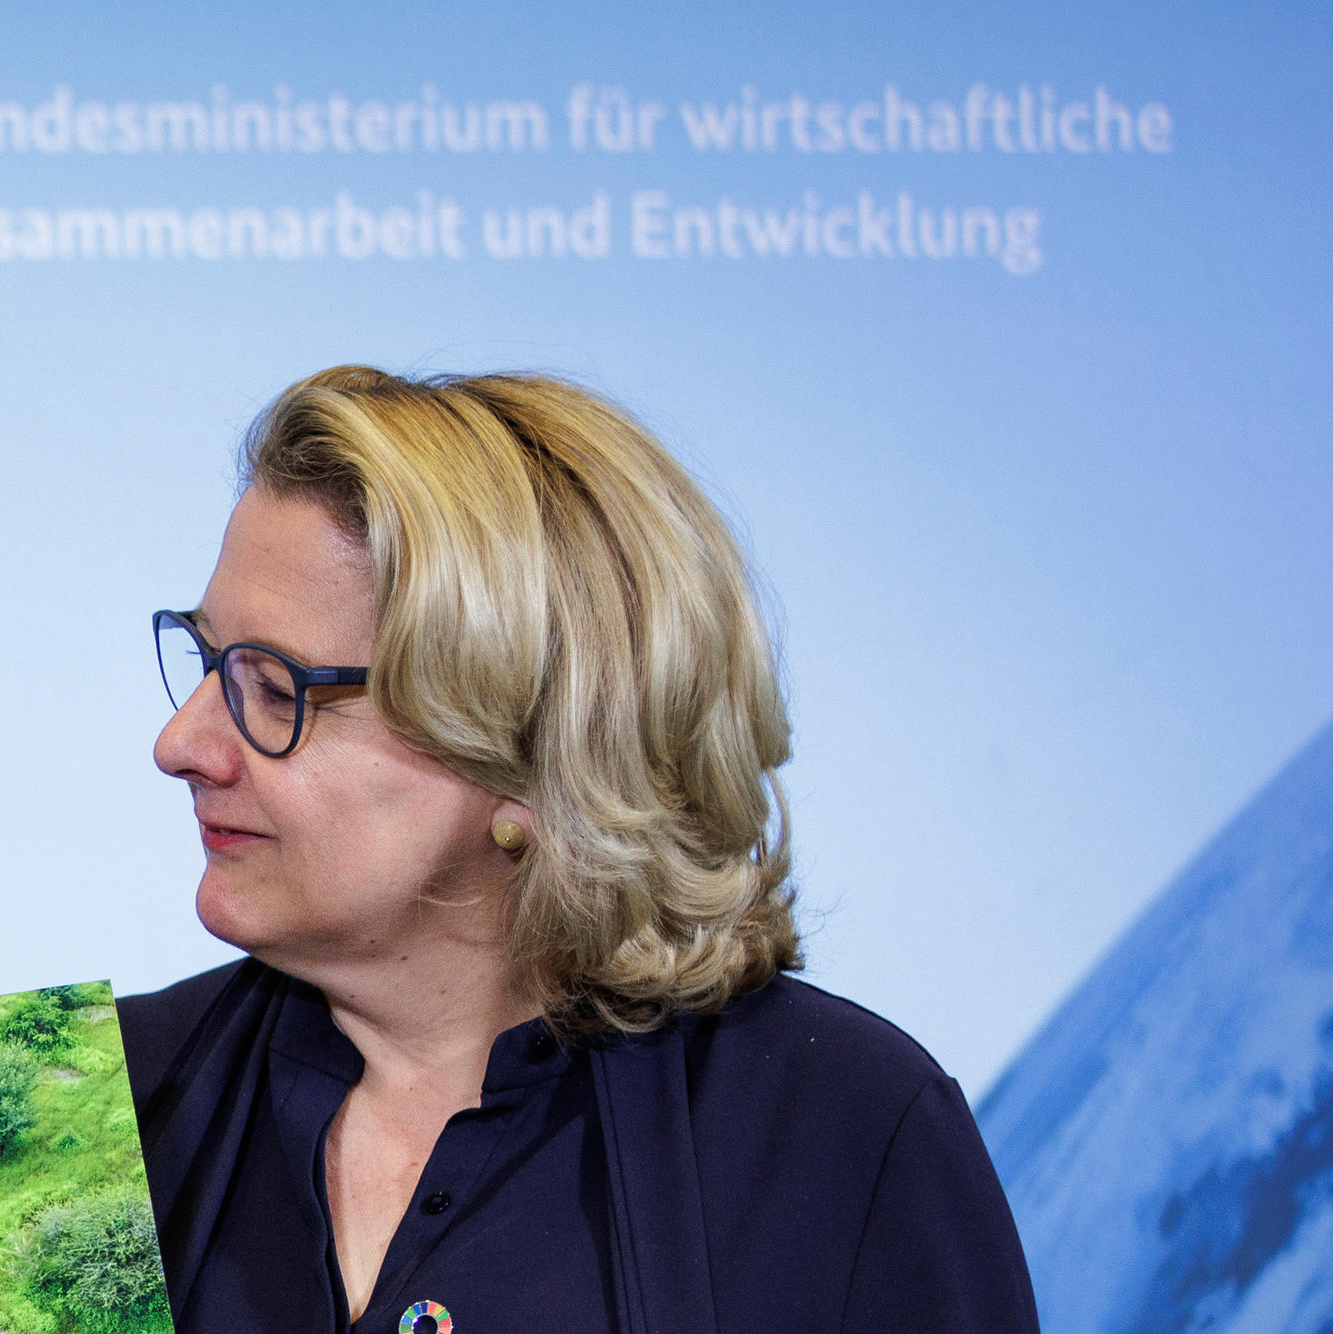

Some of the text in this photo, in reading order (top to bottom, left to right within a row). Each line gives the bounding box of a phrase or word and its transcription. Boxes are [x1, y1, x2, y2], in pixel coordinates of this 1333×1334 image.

[569, 82, 663, 153] für
[683, 82, 1174, 155] wirtschaftliche
[483, 190, 611, 259] und
[632, 190, 1043, 274] Entwicklung
